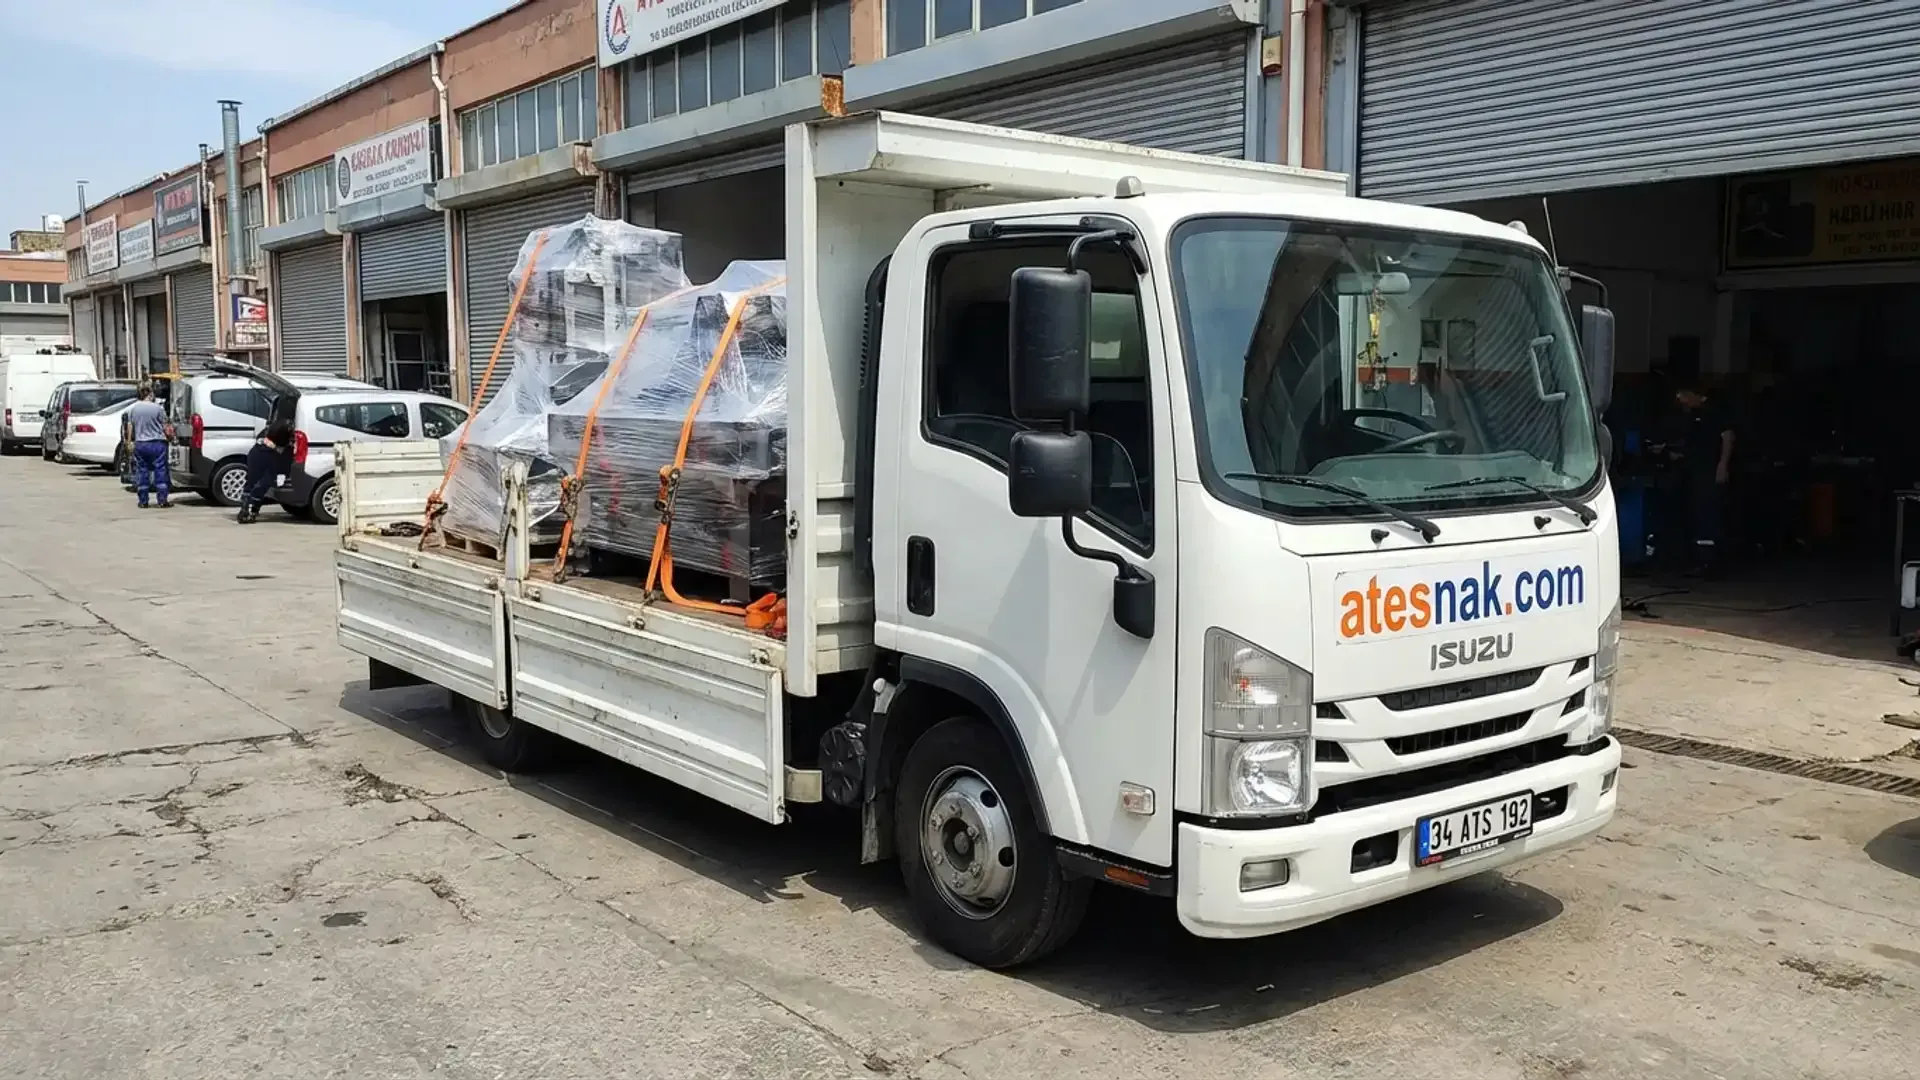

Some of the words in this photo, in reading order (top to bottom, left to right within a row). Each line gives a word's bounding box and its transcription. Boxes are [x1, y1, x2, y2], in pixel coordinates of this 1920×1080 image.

[1339, 560, 1584, 638] atesnak.com
[1430, 632, 1514, 671] ISUZU
[1430, 819, 1453, 850] 34
[1460, 808, 1492, 844] ATS
[1501, 798, 1529, 831] 192
